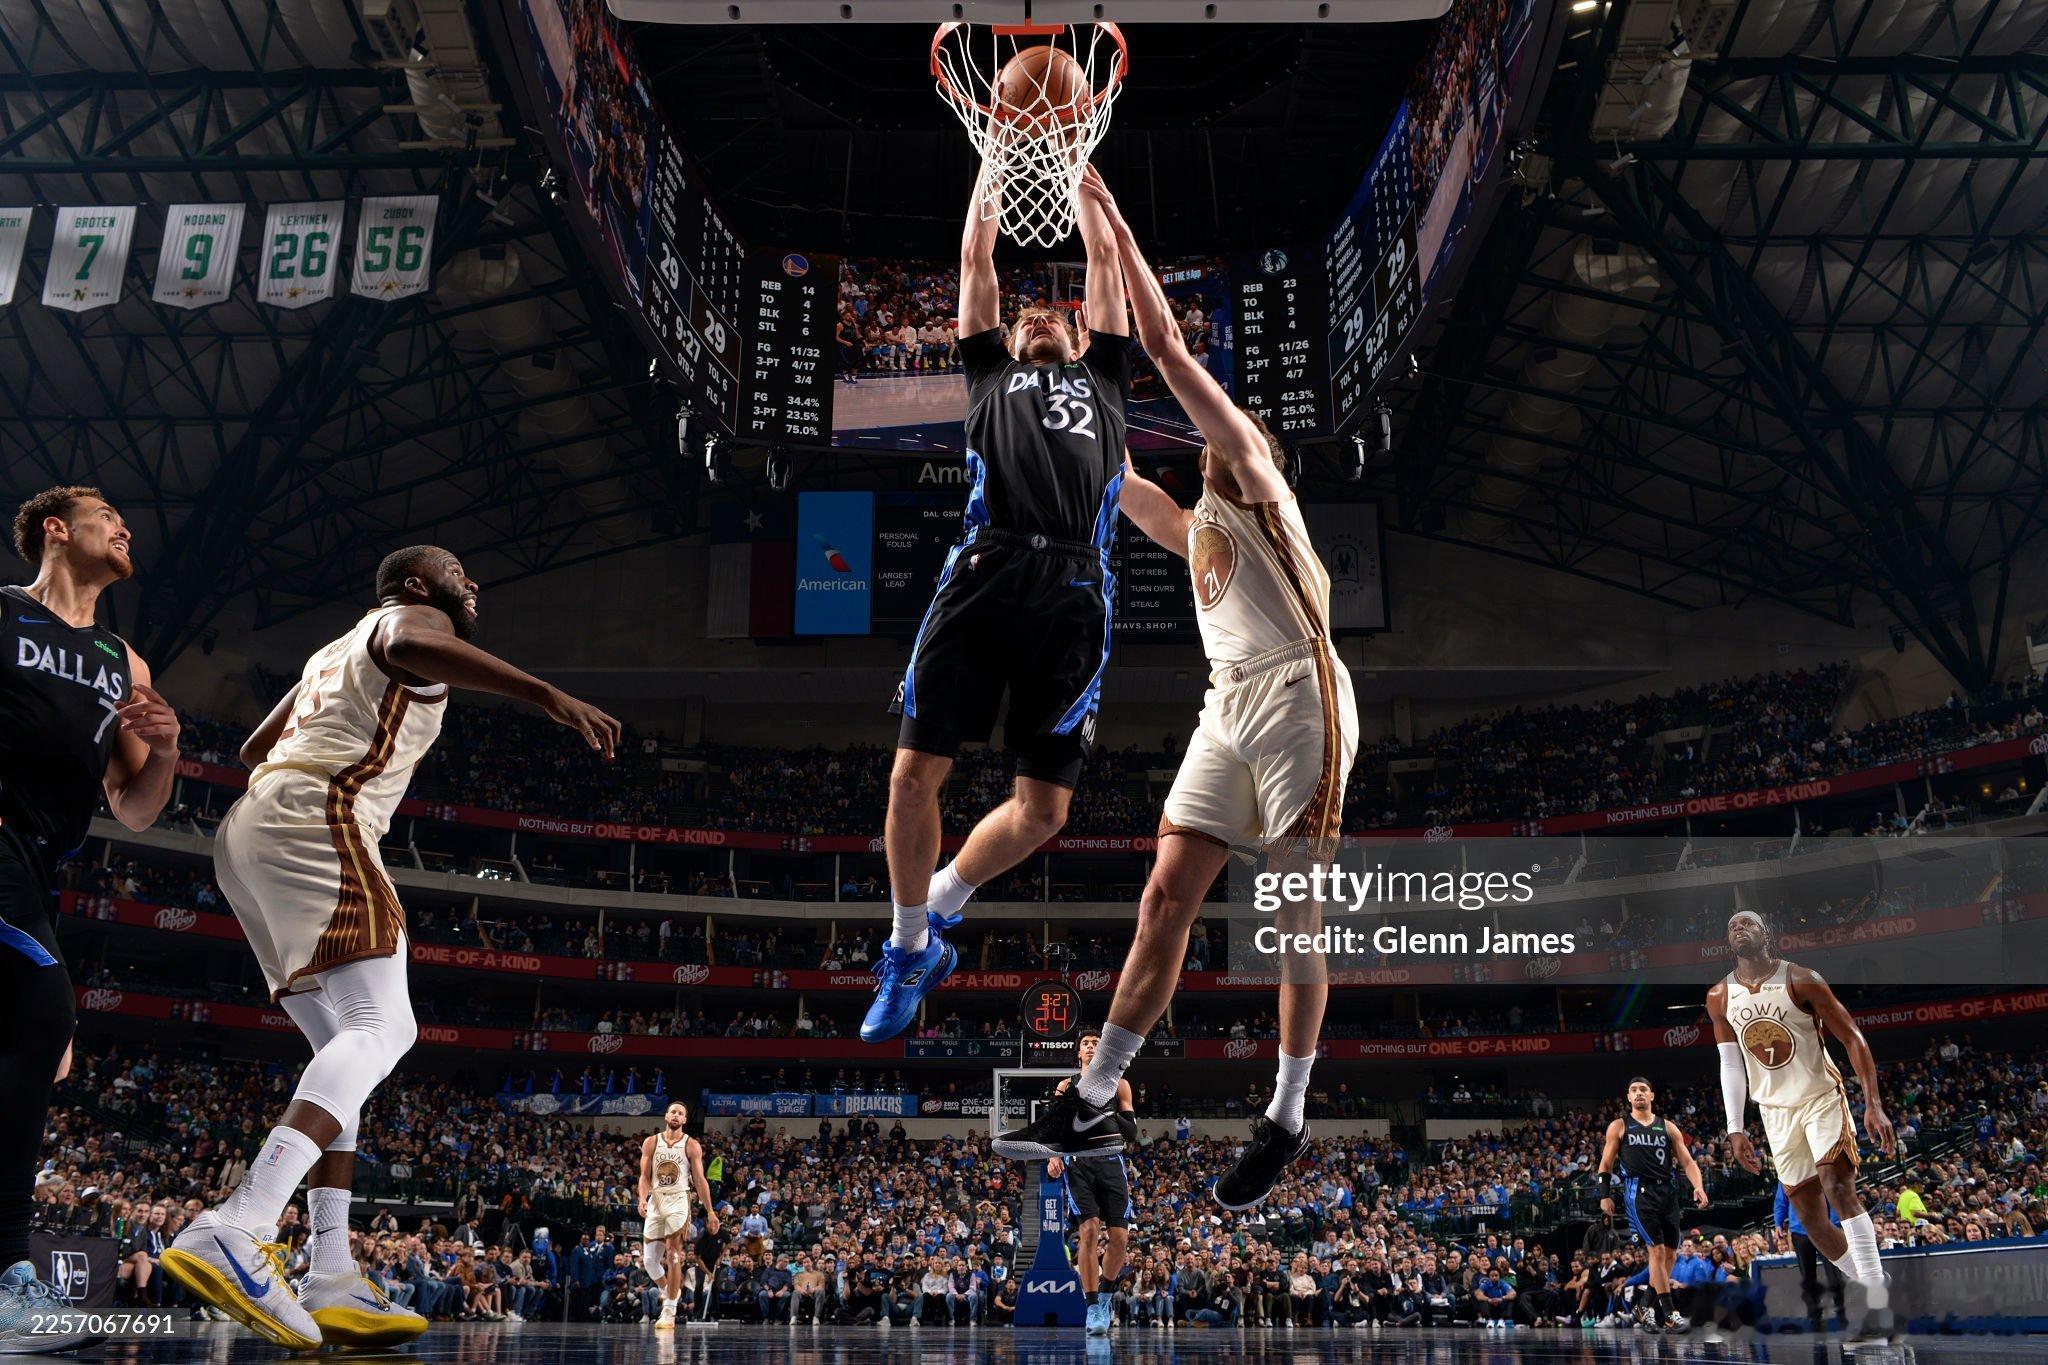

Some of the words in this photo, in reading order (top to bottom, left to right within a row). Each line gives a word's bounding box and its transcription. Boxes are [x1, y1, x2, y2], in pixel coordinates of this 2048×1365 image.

[183, 214, 226, 226] MODANO
[280, 214, 329, 226] LEHTINEN
[383, 208, 414, 219] ZUBOV
[74, 216, 116, 228] BROTEN
[181, 234, 213, 280] 9
[269, 231, 329, 279] 26
[364, 226, 424, 272] 56
[75, 235, 105, 280] 7
[659, 241, 679, 290] 29
[1387, 237, 1406, 288] 29
[761, 280, 782, 291] REB
[802, 285, 816, 296] 14
[1243, 283, 1264, 293] REB
[1283, 279, 1297, 289] 23
[1338, 263, 1363, 301] THOMPSON
[651, 279, 663, 305] TOL
[664, 299, 670, 314] 6
[760, 294, 774, 304] TO
[803, 300, 811, 309] 4
[1243, 298, 1258, 307] TO
[1287, 293, 1294, 302] 9
[1396, 292, 1407, 311] TOL
[1407, 278, 1413, 292] 6
[650, 305, 660, 329] FLS
[759, 308, 780, 319] BLK
[803, 314, 810, 323] 2
[1244, 311, 1264, 320] BLK
[1288, 307, 1295, 316] 3
[1330, 314, 1336, 327] 32
[1338, 293, 1354, 316] FLAGG
[704, 309, 726, 355] 29
[758, 321, 777, 332] STL
[802, 327, 809, 336] 6
[1244, 324, 1263, 334] STL
[1288, 321, 1296, 330] 4
[1343, 306, 1364, 353] 29
[1397, 316, 1408, 336] FLS
[675, 314, 701, 364] 9:27
[1365, 311, 1389, 364] 9:27
[757, 343, 771, 353] FG
[790, 346, 820, 358] 11/32
[1246, 346, 1260, 356] FG
[1278, 340, 1309, 352] 11/26
[756, 356, 780, 367] 3-PT
[791, 360, 816, 371] 4/17
[1246, 359, 1270, 369] 3-PT
[1282, 354, 1307, 365] 3/12
[708, 360, 720, 383] TOL
[722, 377, 728, 393] 6
[755, 370, 768, 380] FT
[794, 374, 812, 385] 3/4
[1247, 373, 1260, 383] FT
[1286, 369, 1303, 379] 4/7
[1340, 373, 1352, 391] TOL
[1353, 360, 1359, 374] 6
[1007, 372, 1091, 399] DALAS
[706, 385, 719, 406] FLS
[754, 391, 768, 402] FG
[787, 396, 820, 408] 34.4%
[1248, 395, 1262, 405] FG
[1281, 389, 1315, 401] 42.3%
[1342, 392, 1353, 413] FLS
[1355, 383, 1360, 397] 0
[753, 406, 777, 417] 3-PT
[786, 410, 819, 421] 23.5%
[1042, 394, 1096, 439] 32
[1282, 404, 1315, 416] 25.0%
[752, 420, 765, 430] FT
[786, 424, 819, 436] 75.0%
[1282, 418, 1316, 431] 57.1%
[923, 510, 940, 518] DAL
[942, 510, 961, 518] GSW
[1130, 552, 1145, 560] DEF
[1147, 552, 1168, 560] REBS
[1130, 568, 1146, 576] TOT
[1148, 568, 1168, 576] REBS
[797, 578, 866, 591] American
[885, 580, 905, 588] LEAD
[1204, 567, 1221, 600] 21
[94, 639, 120, 659] chime
[16, 636, 123, 700] DALLAS
[93, 697, 118, 744] 7
[1607, 805, 1659, 823] NOTHING
[1661, 803, 1685, 816] BUT
[1686, 780, 1831, 814] ONE-OF-A-KIND
[518, 817, 569, 833] NOTHING
[570, 822, 594, 835] BUT
[594, 824, 726, 845] ONE-OF-A-KIND
[1059, 838, 1110, 849] NOTHING
[1111, 838, 1131, 848] BUT
[154, 910, 197, 931] Pepper
[170, 907, 187, 918] Dr
[1778, 917, 1916, 950] ONE-OF-A-KIND
[414, 945, 541, 971] ONE-OF-A-KIND
[673, 967, 709, 984] Pepper
[685, 963, 701, 974] Dr
[1086, 969, 1102, 980] Dr
[830, 975, 876, 985] NOTHING
[1075, 973, 1111, 991] Pepper
[1216, 976, 1262, 986] NOTHING
[81, 991, 123, 1012] Pepper
[95, 988, 113, 999] Dr
[1041, 994, 1069, 1006] 9:27
[1035, 1008, 1067, 1031] 24
[1732, 1002, 1788, 1027] TOWN
[1891, 1010, 1914, 1023] BUT
[587, 1036, 623, 1054] Pepper
[1040, 1041, 1075, 1050] TISSOT
[1663, 1028, 1700, 1048] Pepper
[918, 1048, 925, 1057] 6
[946, 1048, 952, 1057] 0
[1000, 1048, 1012, 1057] 29
[1163, 1048, 1170, 1057] 6
[1223, 1042, 1257, 1059] Pepper
[1360, 1044, 1405, 1054] NOTHING
[1407, 1043, 1427, 1053] BUT
[1428, 1038, 1550, 1055] ONE-OF-A-KIND
[1764, 1047, 1774, 1065] 7
[775, 1097, 807, 1106] SOUND
[776, 1105, 806, 1113] STAGE
[845, 1095, 902, 1114] BREAKERS
[1627, 1133, 1666, 1147] DALLAS
[655, 1152, 684, 1166] TOWN
[1655, 1148, 1666, 1166] 9
[660, 1175, 672, 1185] 30
[1045, 1198, 1057, 1209] GET
[1045, 1210, 1057, 1220] THE
